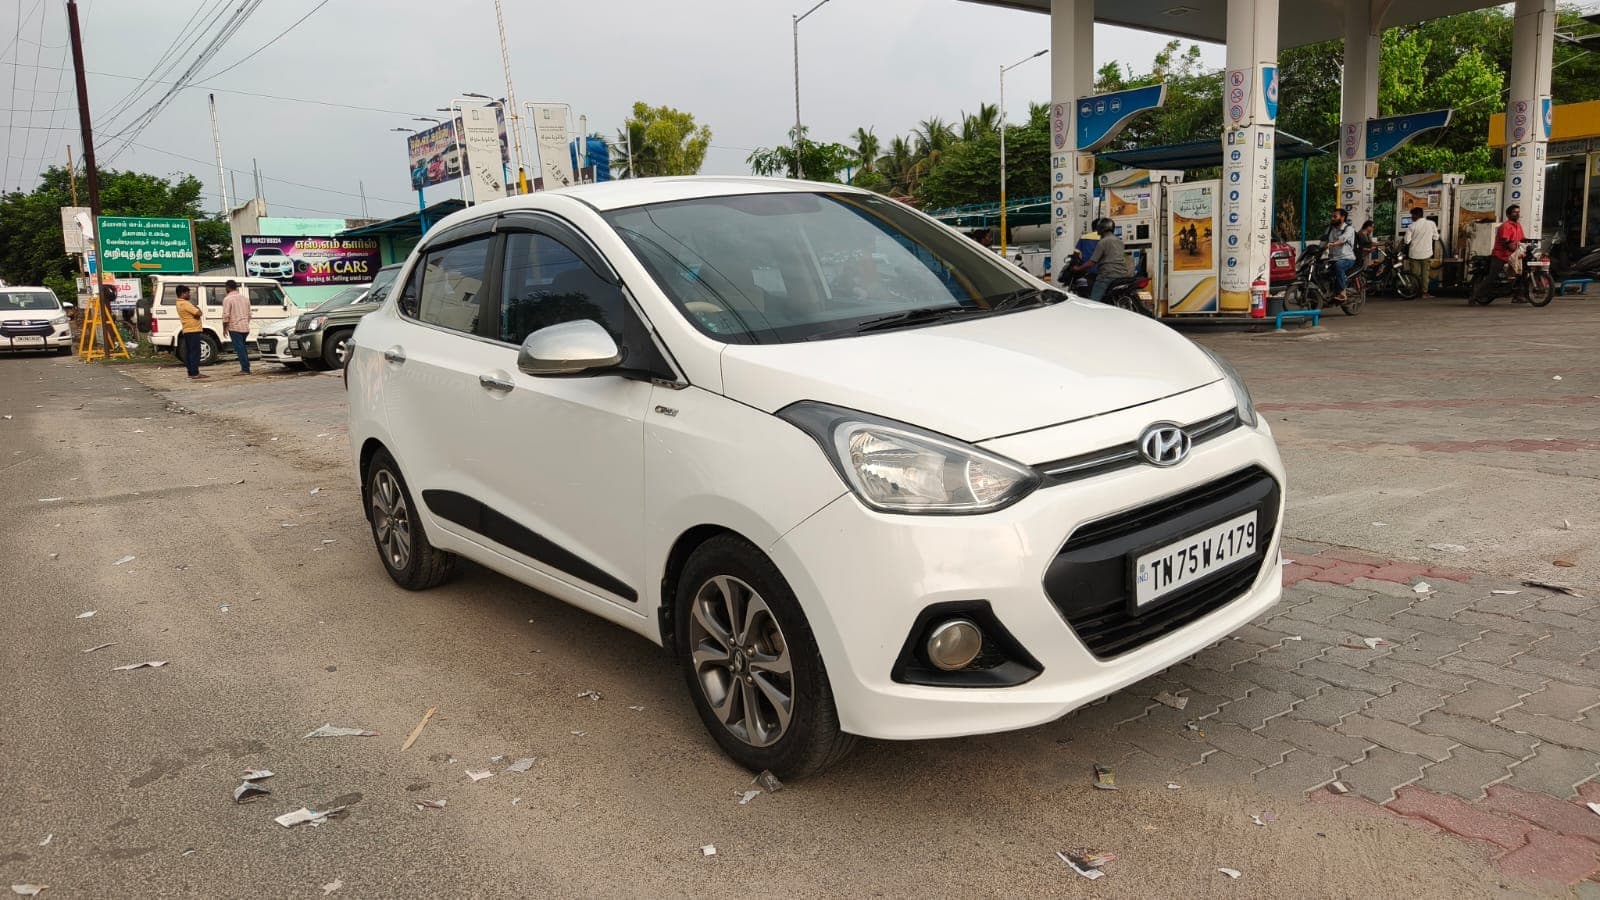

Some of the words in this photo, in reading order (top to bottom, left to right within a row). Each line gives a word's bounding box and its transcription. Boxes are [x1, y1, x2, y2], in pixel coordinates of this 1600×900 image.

[1083, 127, 1088, 139] 1
[1372, 142, 1379, 152] 3
[311, 261, 331, 274] SM
[333, 260, 368, 273] CARS
[1151, 521, 1255, 590] TN75W4179
